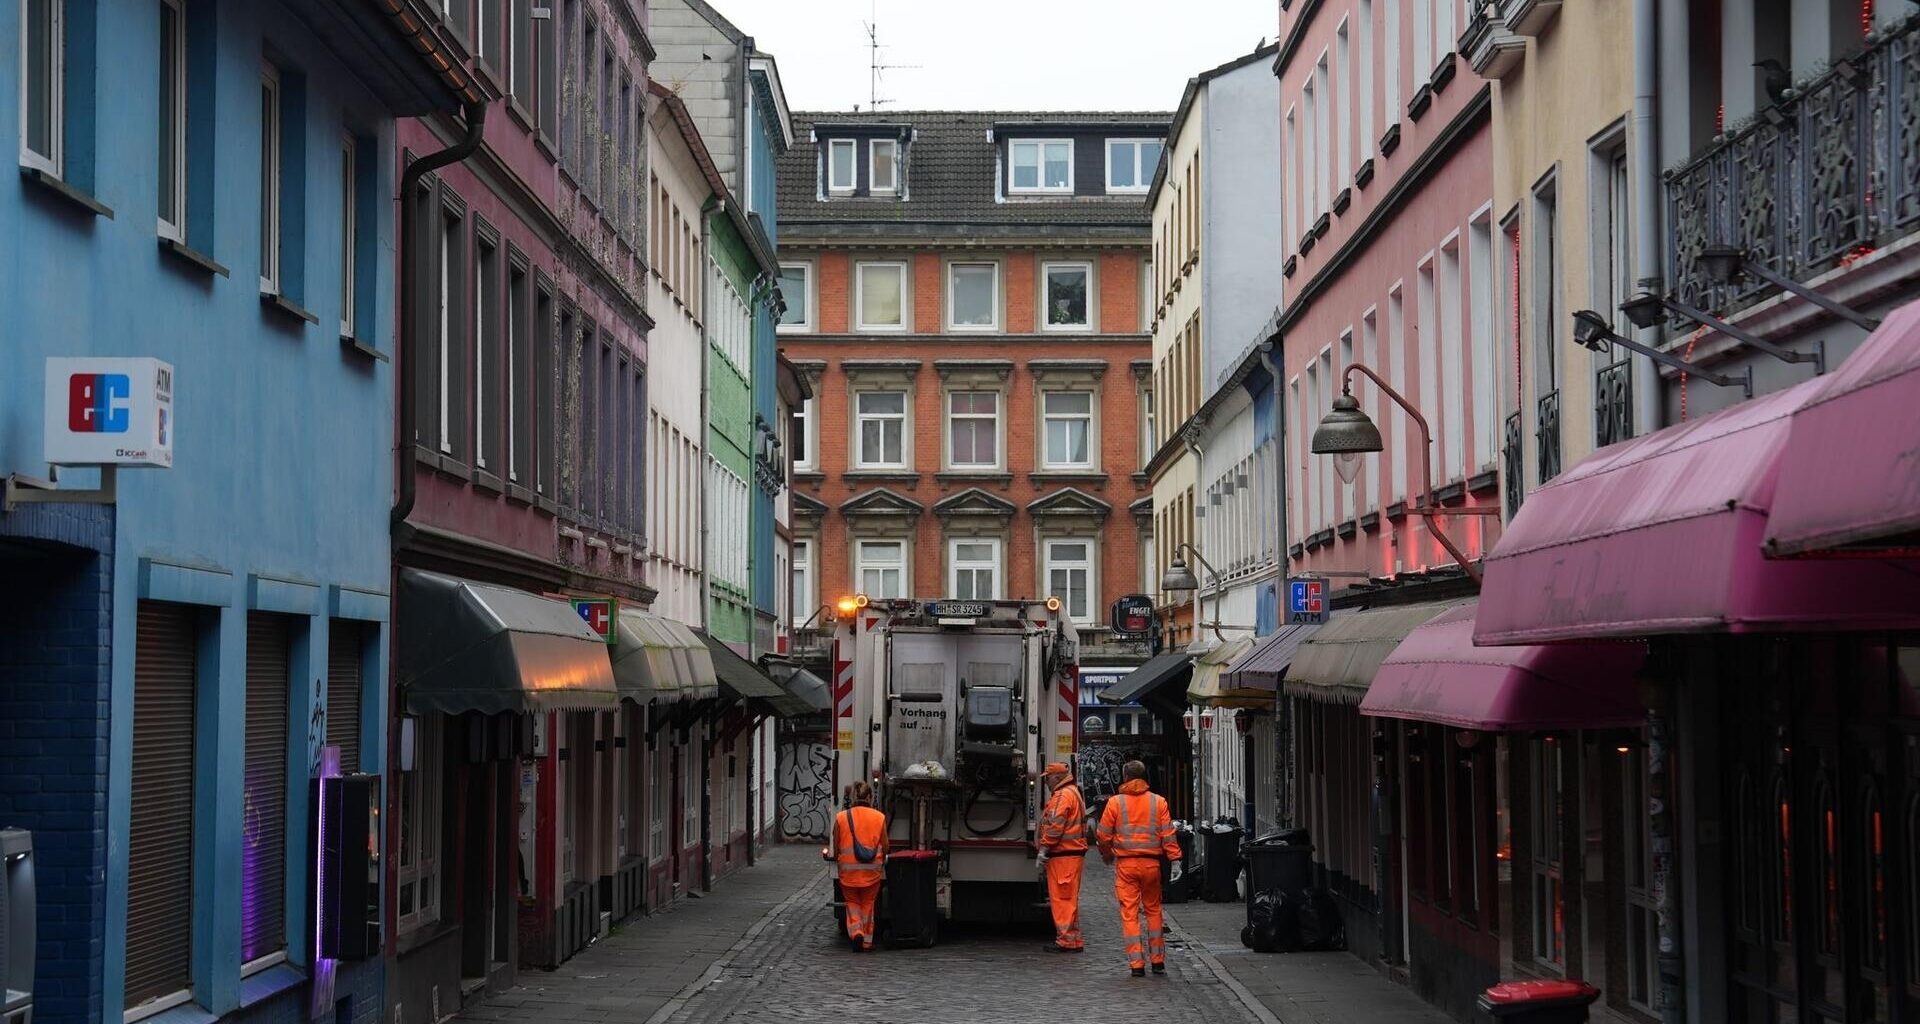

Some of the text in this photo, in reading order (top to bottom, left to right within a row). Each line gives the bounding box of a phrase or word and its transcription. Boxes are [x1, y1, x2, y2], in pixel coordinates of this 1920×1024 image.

[156, 367, 171, 393] ATM
[936, 604, 946, 613] HH
[962, 604, 982, 614] 3245
[1129, 606, 1151, 615] ENGEL
[1293, 612, 1321, 622] ATM
[1084, 675, 1118, 685] SPORTPUB
[900, 708, 947, 720] Vorhang
[900, 720, 918, 729] auf
